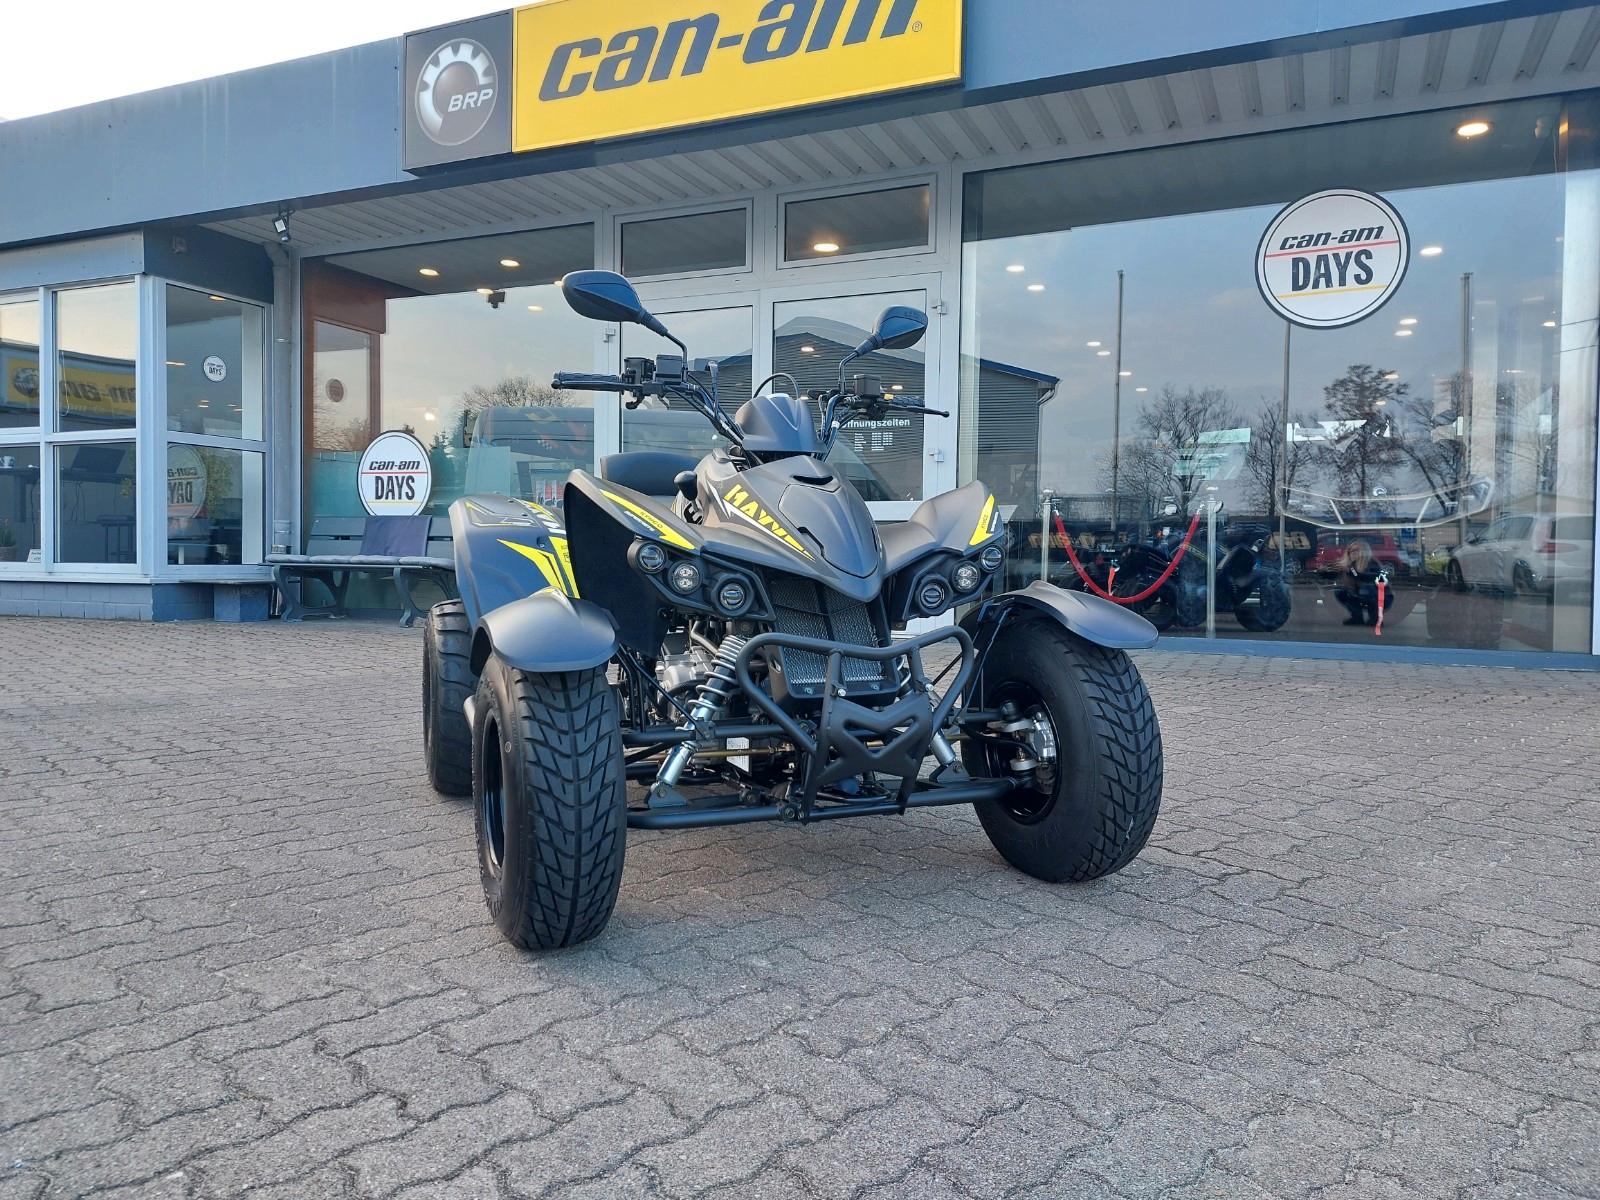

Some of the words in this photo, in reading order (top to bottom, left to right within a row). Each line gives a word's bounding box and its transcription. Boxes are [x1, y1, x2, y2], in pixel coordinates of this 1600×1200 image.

[539, 0, 917, 101] can-am
[447, 88, 493, 112] BRP
[1279, 226, 1384, 250] can-am
[1291, 249, 1373, 292] DAYS
[841, 418, 911, 429] ffnungszeiten
[369, 461, 420, 471] can-am
[374, 476, 415, 501] DAYS
